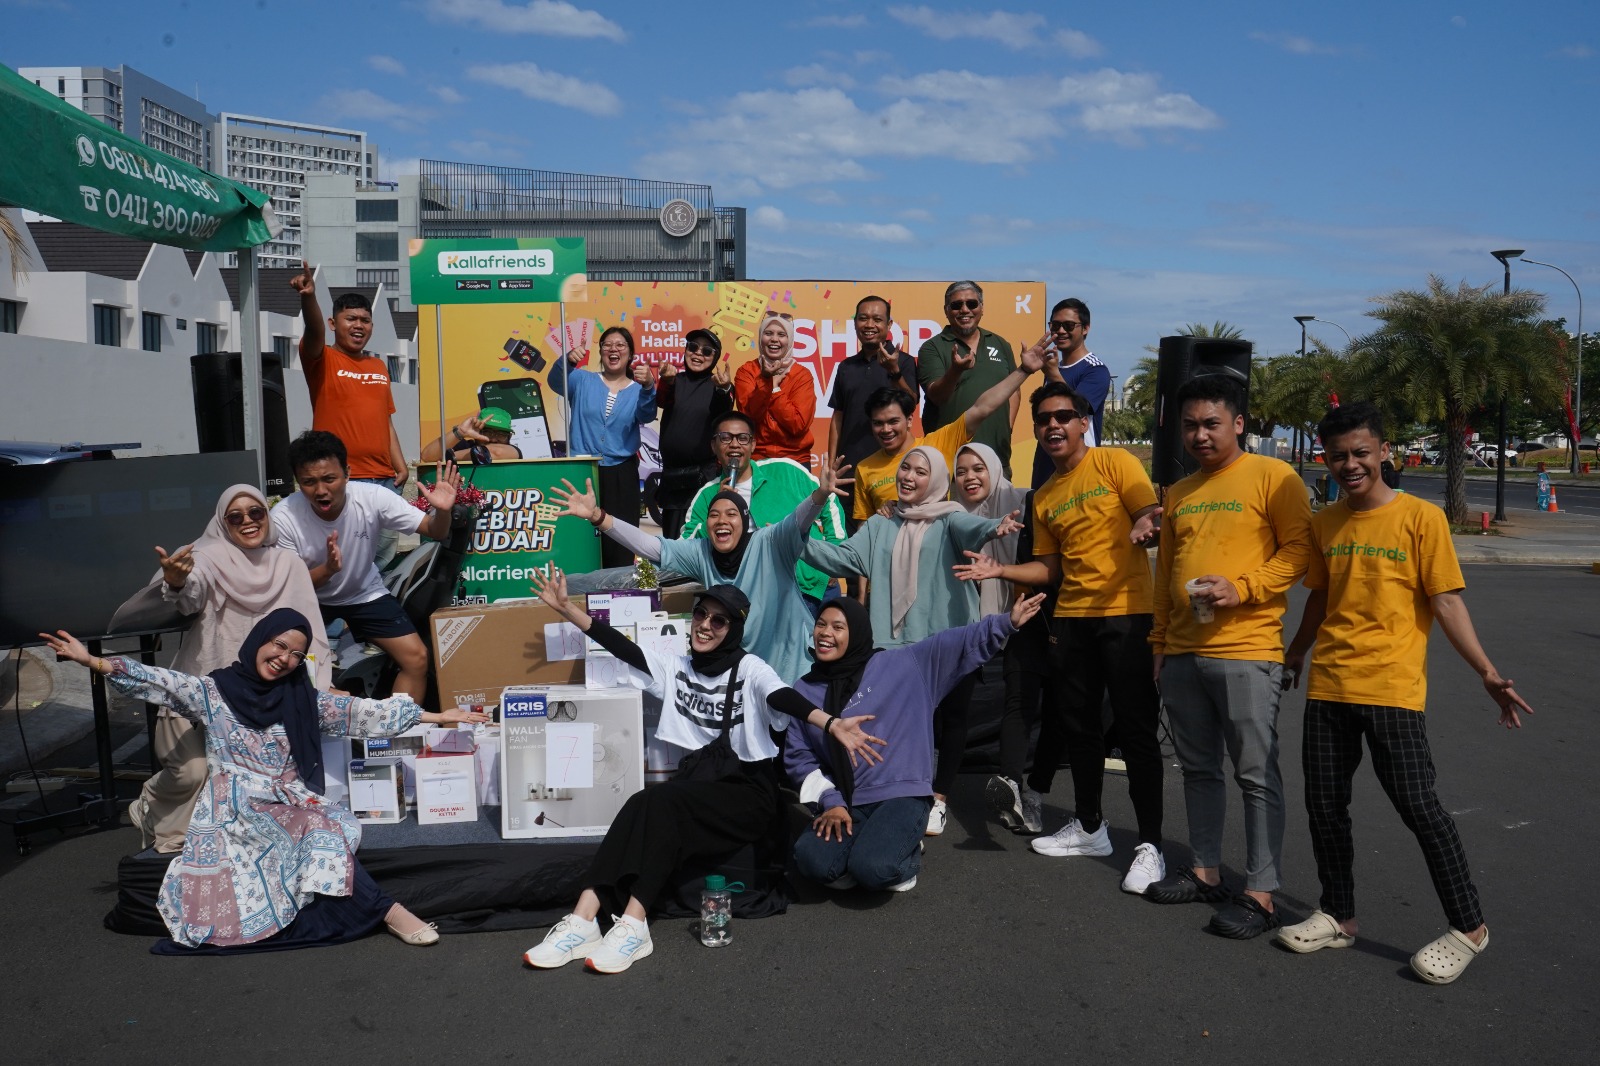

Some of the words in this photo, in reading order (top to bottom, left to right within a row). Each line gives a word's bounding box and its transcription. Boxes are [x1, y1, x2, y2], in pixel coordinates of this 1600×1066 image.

[99, 141, 143, 180] 0811
[105, 188, 148, 226] 0411
[152, 200, 188, 234] 300
[447, 254, 546, 269] Kallafriends
[641, 319, 682, 332] Total
[551, 334, 563, 348] CHER
[641, 334, 688, 348] Hadia
[632, 352, 685, 363] PULUH
[337, 369, 388, 382] UNITED
[486, 489, 541, 509] DUP
[475, 510, 535, 530] EBIH
[467, 529, 550, 551] UDAH
[465, 563, 560, 581] llafriends
[441, 619, 465, 647] xiaomi
[507, 701, 545, 712] KRIS
[369, 749, 412, 757] HUMIDIFIER
[510, 817, 520, 825] 16
